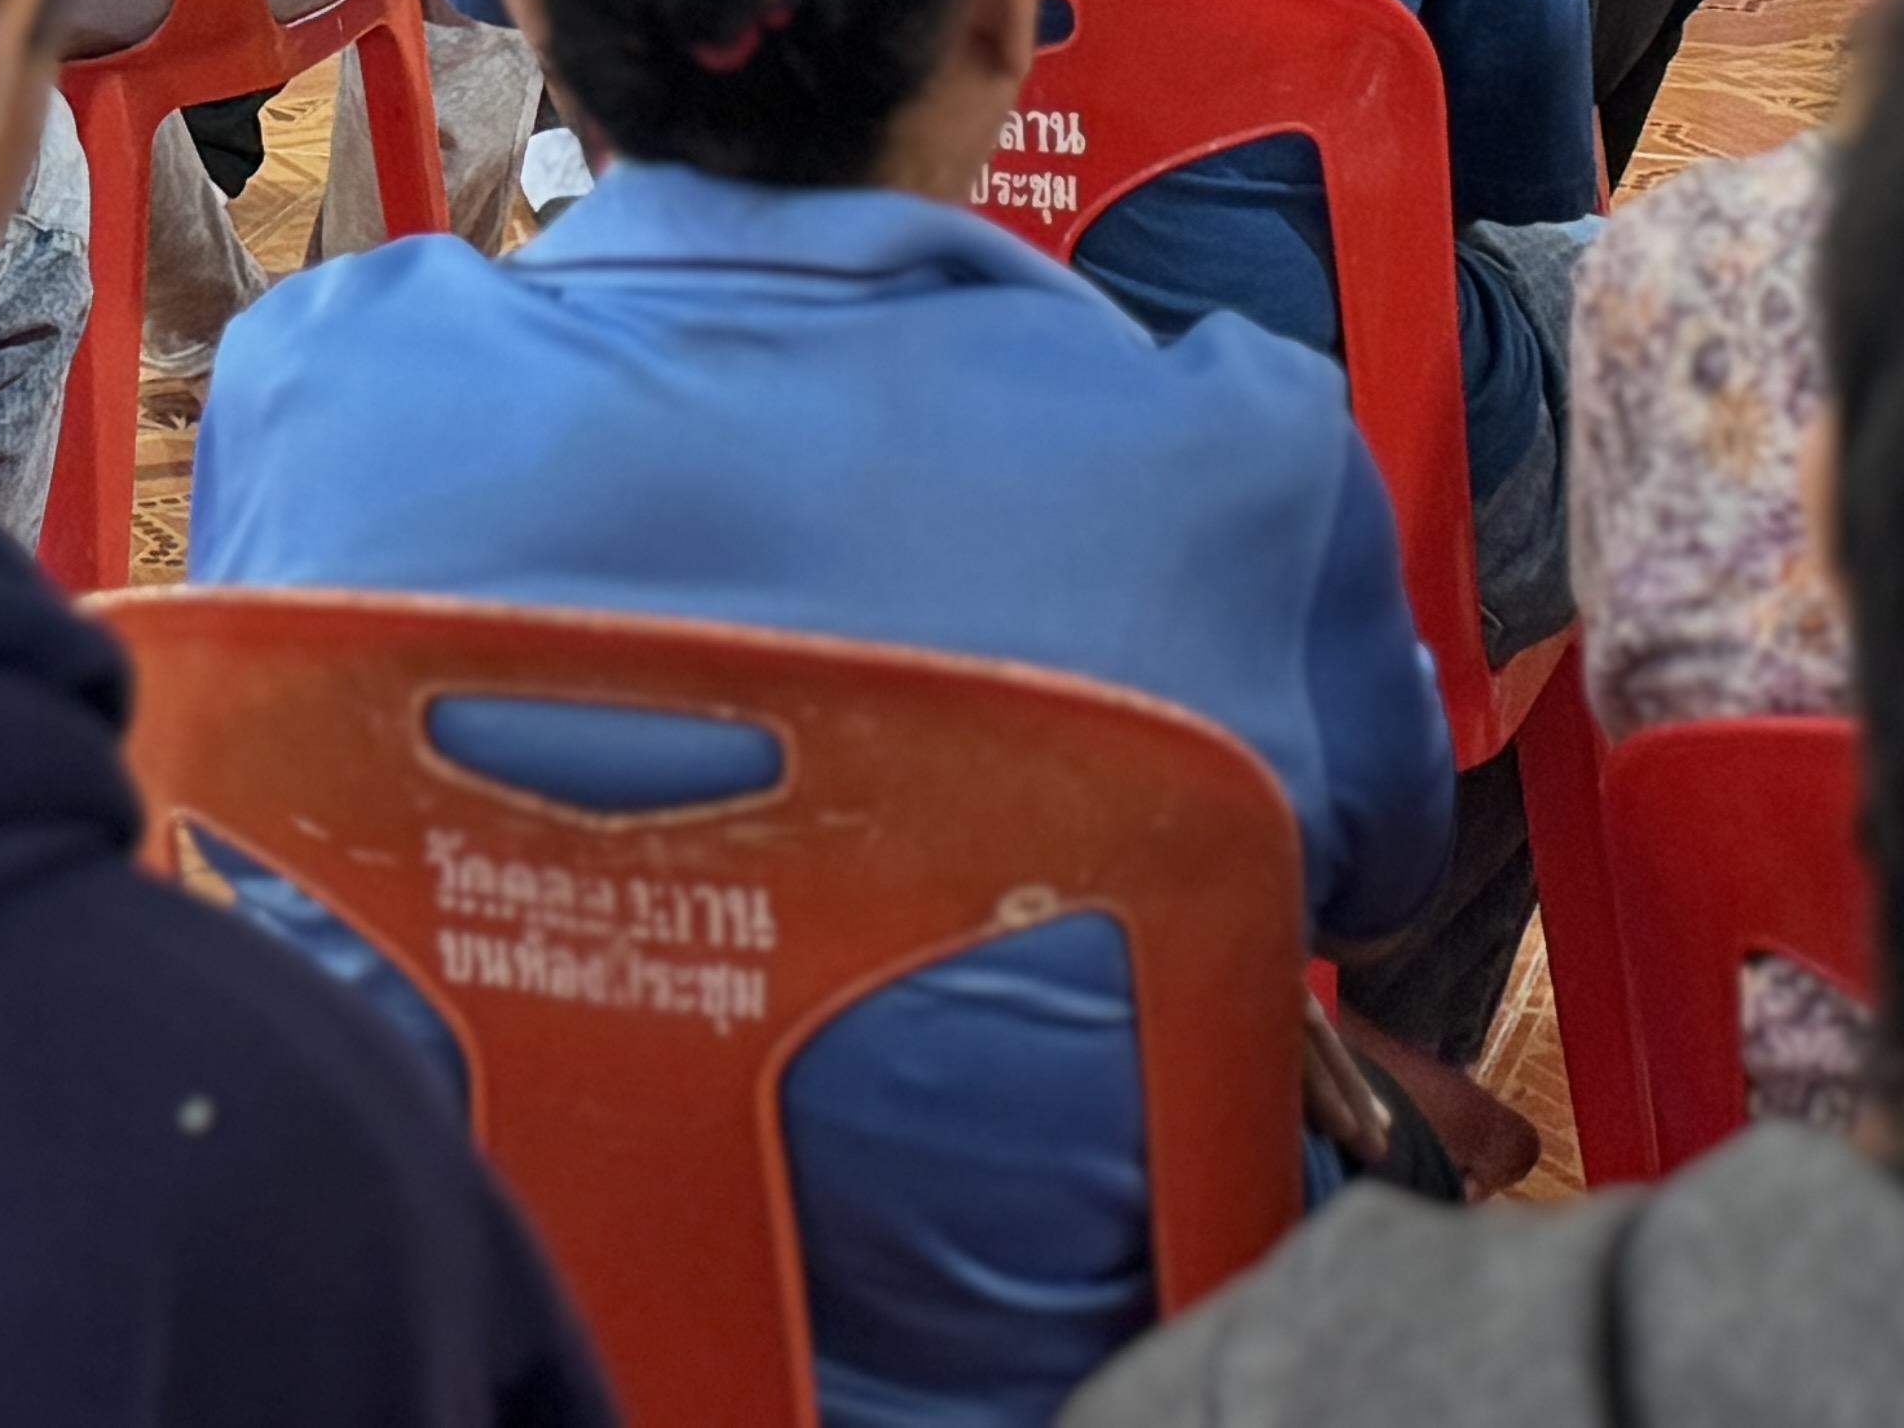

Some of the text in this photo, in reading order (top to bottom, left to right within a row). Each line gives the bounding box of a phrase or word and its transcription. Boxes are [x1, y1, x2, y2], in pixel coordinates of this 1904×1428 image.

[998, 109, 1087, 155] ลาน
[969, 161, 1078, 225] ประชุม
